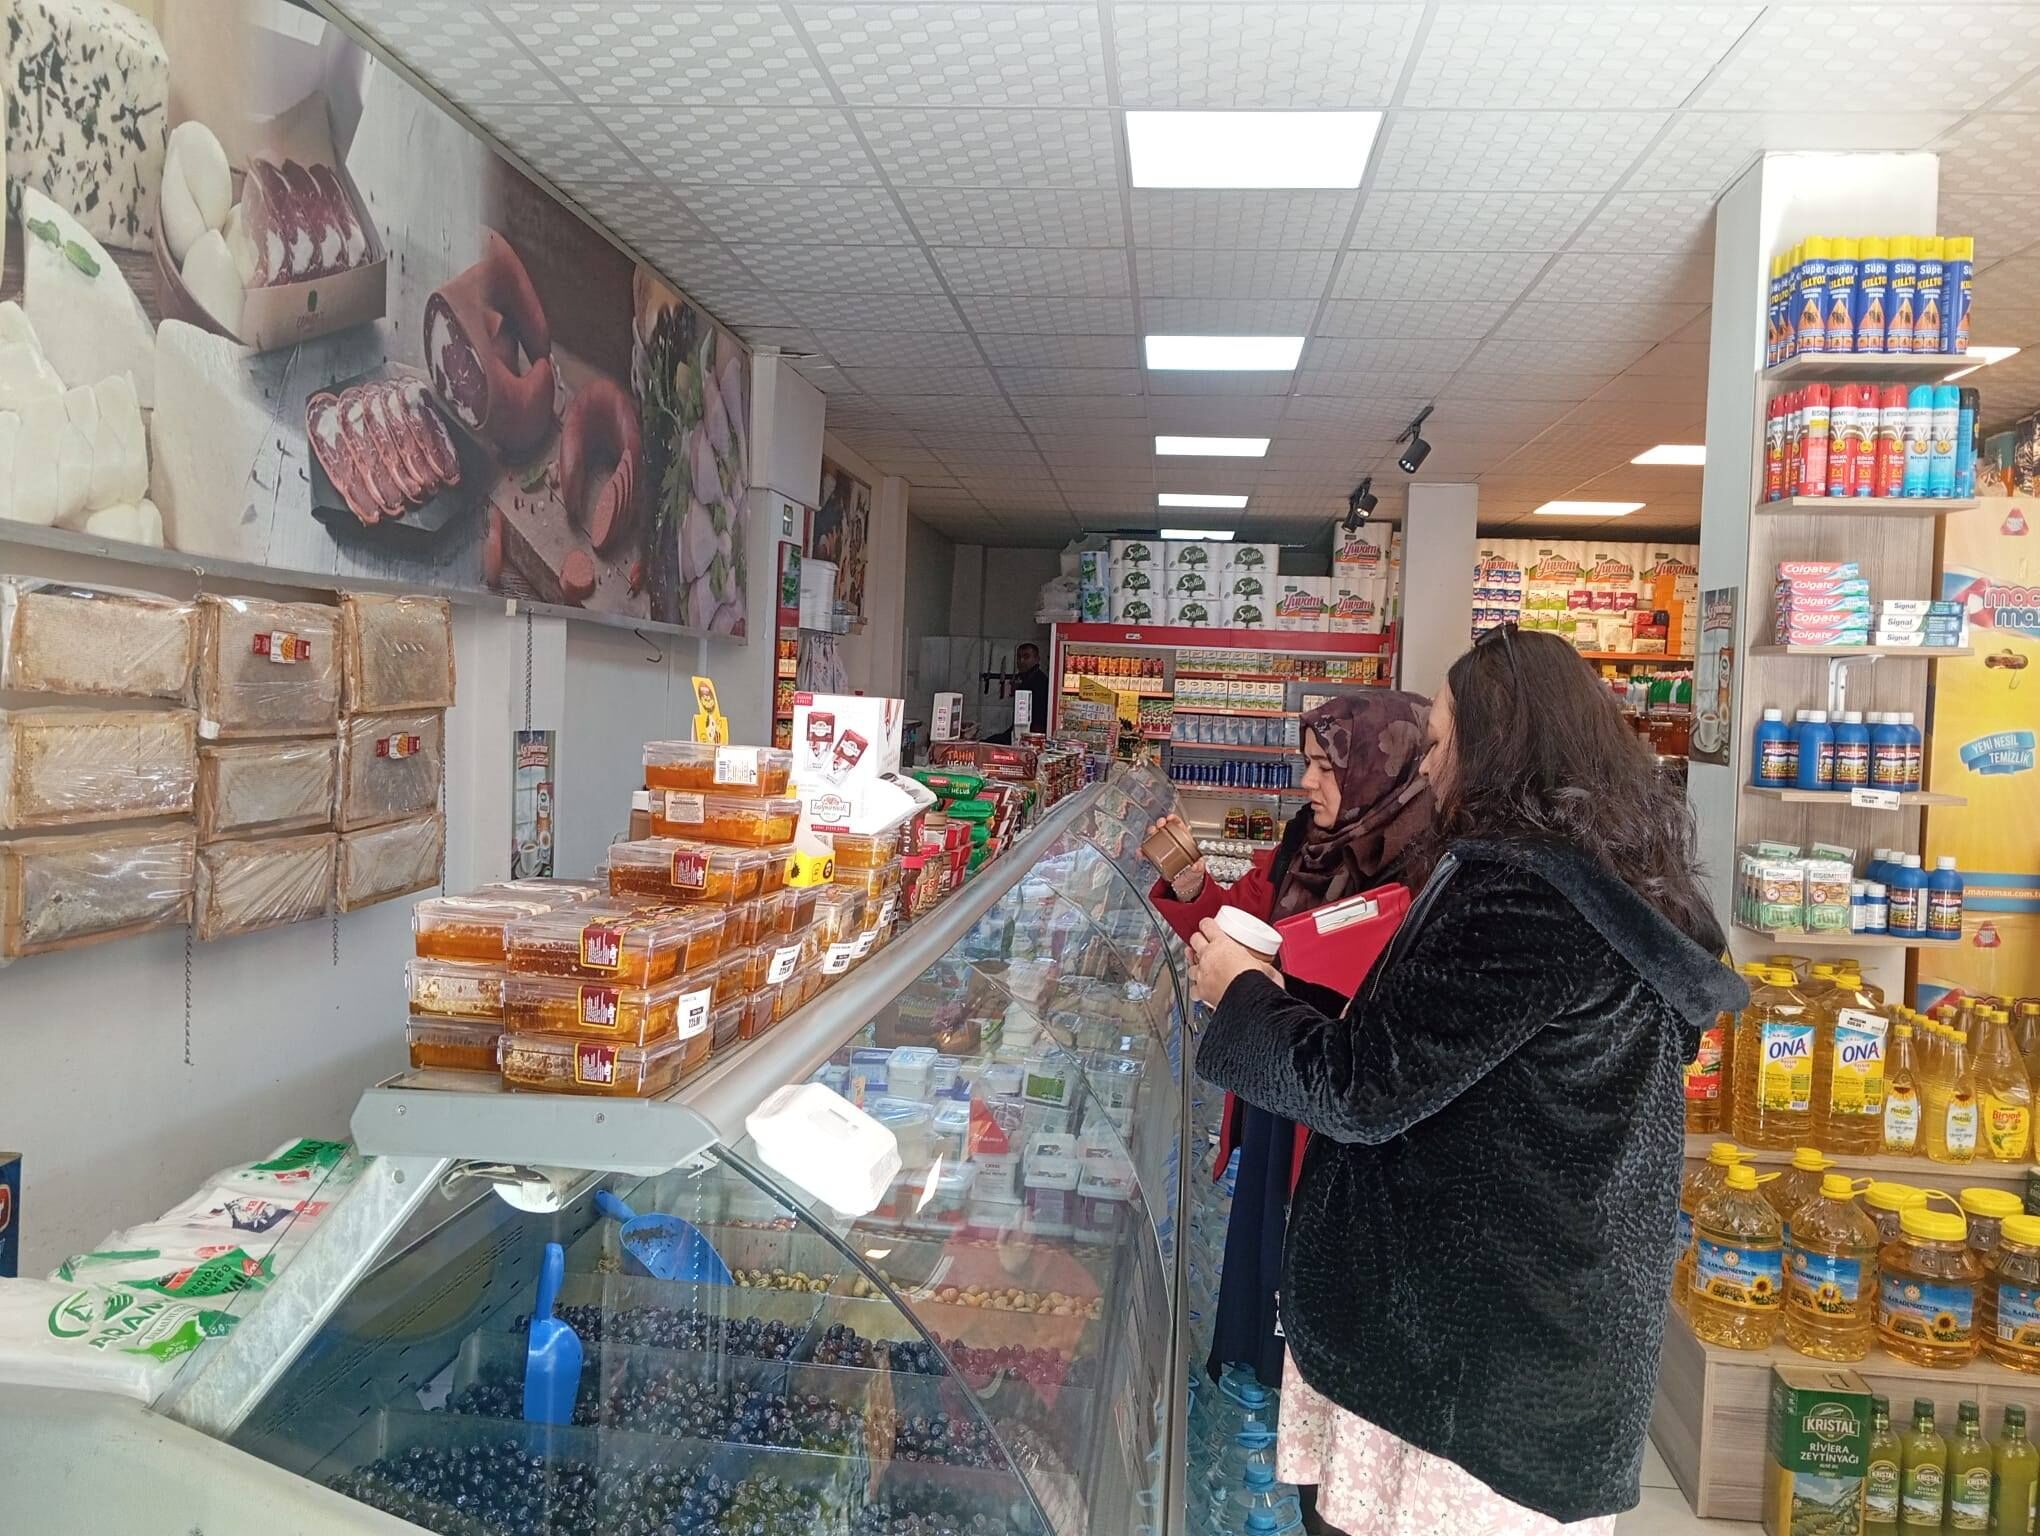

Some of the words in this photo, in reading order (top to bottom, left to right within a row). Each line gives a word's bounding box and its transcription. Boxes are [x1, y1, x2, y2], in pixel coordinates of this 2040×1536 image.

[1862, 276, 1887, 288] KILLTO
[1892, 276, 1916, 288] KILLTO
[1917, 276, 1942, 288] KILLTO
[1785, 563, 1831, 576] Colgate
[1794, 580, 1834, 590] Colgate
[1794, 596, 1834, 606] Colgate
[1894, 602, 1916, 611] Signal
[1793, 612, 1841, 625] Colgate
[1887, 618, 1912, 627] Signal
[1791, 630, 1833, 640] Colgate
[1886, 633, 1910, 642] Signal
[1972, 738, 1992, 754] YENİ
[1989, 749, 2030, 764] TEMİZLİK
[1963, 888, 2040, 899] .macromax.com.t
[1769, 1038, 1807, 1059] ONA
[1842, 1041, 1880, 1063] ONA
[1809, 1441, 1849, 1454] RİVİERA
[1800, 1451, 1859, 1464] ZEYTİNYAĞI
